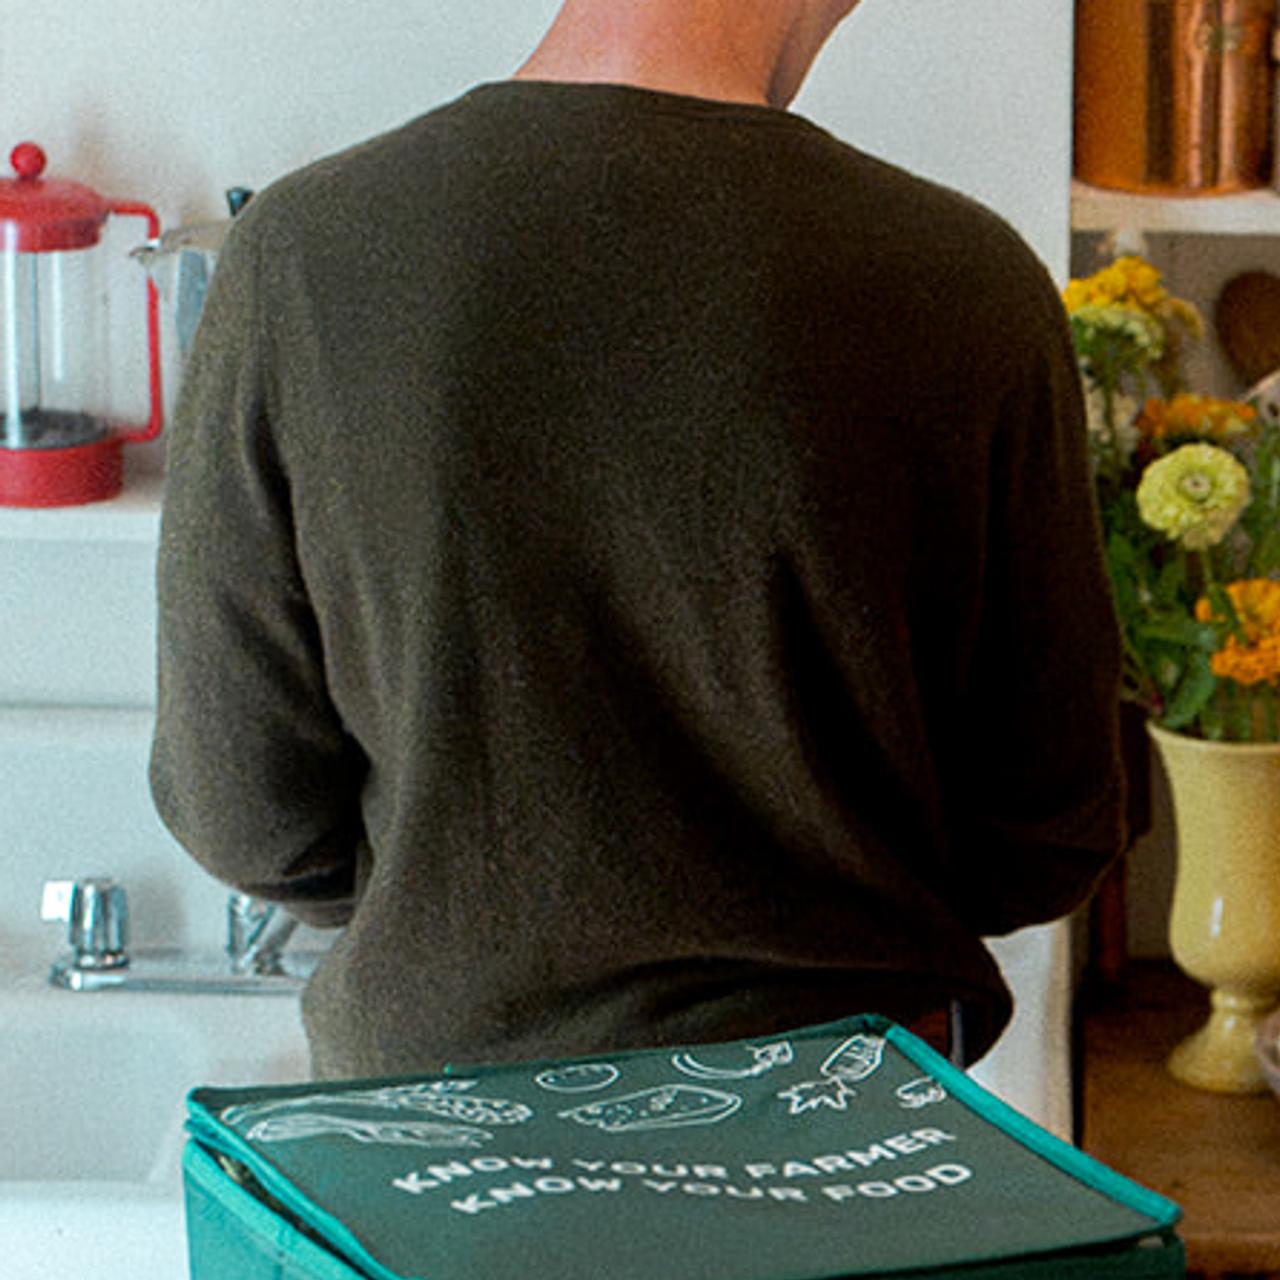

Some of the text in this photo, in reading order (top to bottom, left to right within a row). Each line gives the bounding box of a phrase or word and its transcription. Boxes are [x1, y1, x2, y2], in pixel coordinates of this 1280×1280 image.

[392, 1126, 957, 1194] KNOW YOUR FARMER
[451, 1163, 972, 1214] KNOW YOUR FOOD
